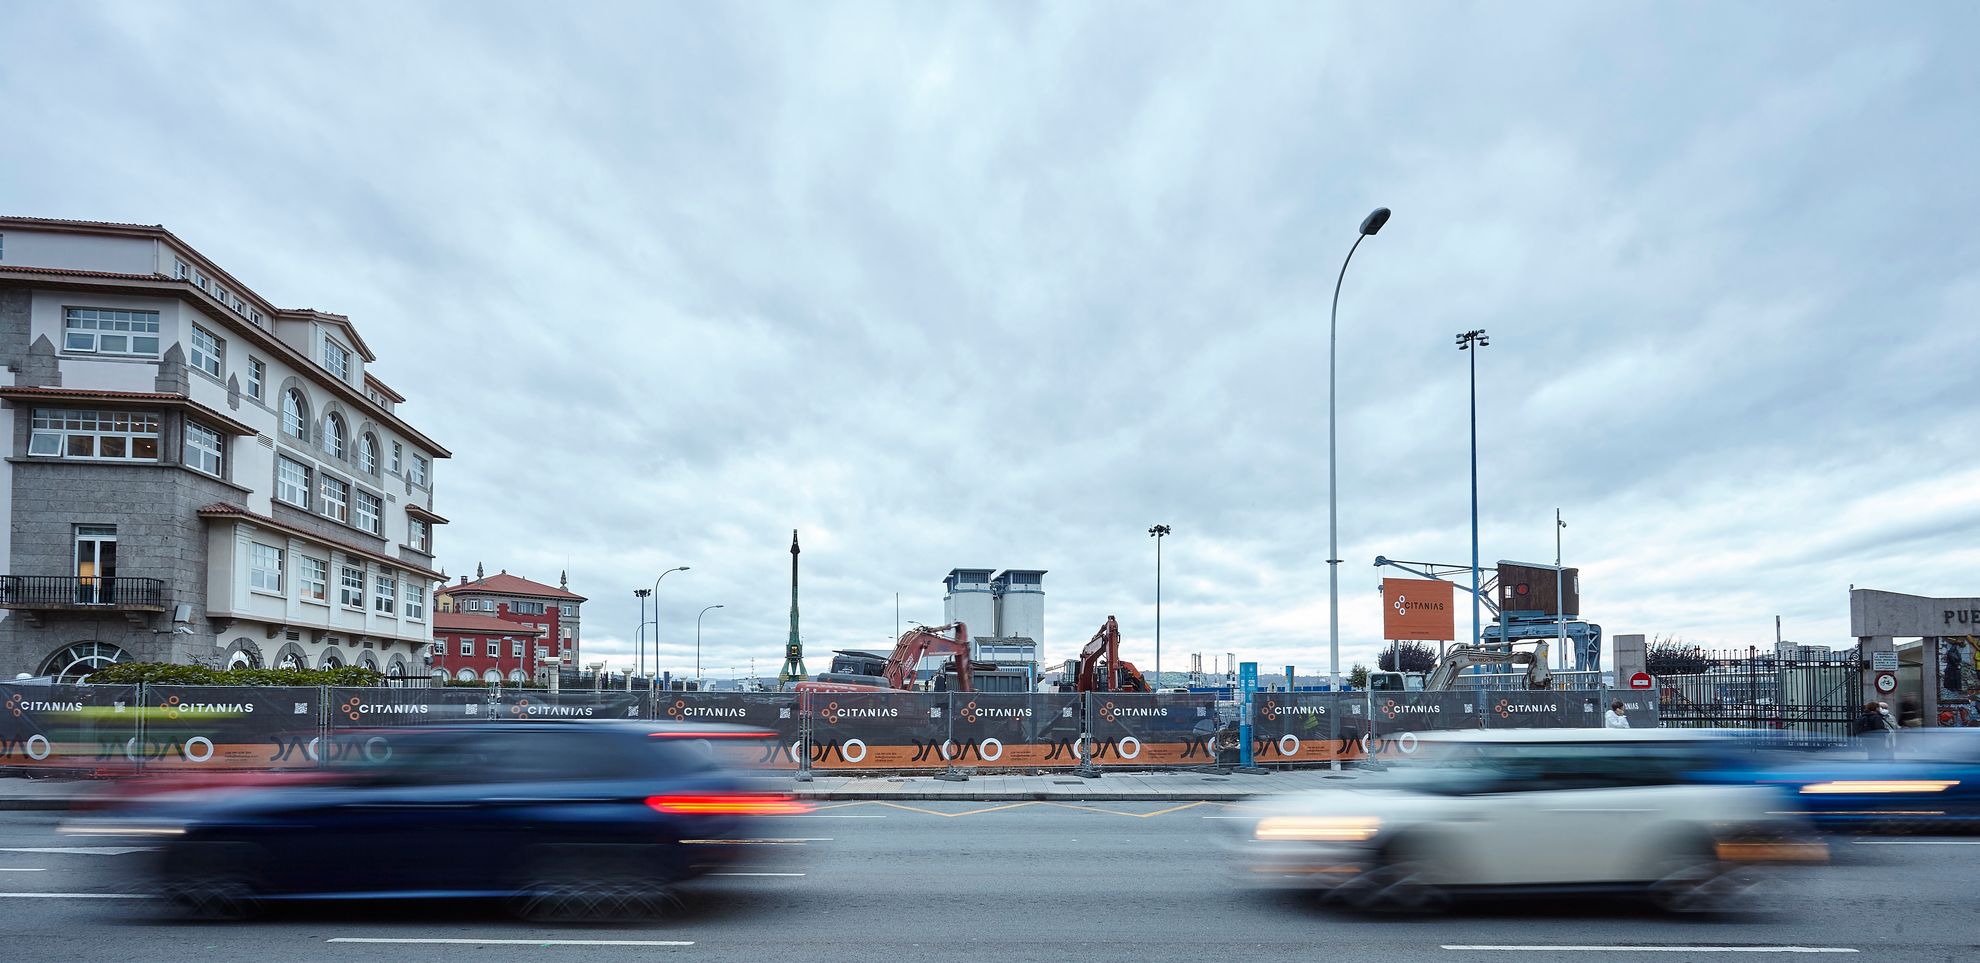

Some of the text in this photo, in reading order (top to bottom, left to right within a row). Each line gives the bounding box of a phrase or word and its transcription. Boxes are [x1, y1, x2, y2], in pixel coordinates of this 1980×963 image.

[1404, 602, 1444, 610] CITANIAS
[20, 701, 83, 712] CITANIAS
[178, 703, 254, 713] CITANIAS
[358, 704, 429, 714] CITANIAS
[528, 706, 593, 716] CITANIAS
[1274, 706, 1326, 715] CITANIAS
[1394, 705, 1440, 714] CITANIAS
[1508, 704, 1557, 712] CITANIAS
[684, 707, 746, 717] CITANIAS
[837, 708, 898, 718] CITANIAS
[975, 708, 1033, 717] CITANIAS
[1114, 708, 1168, 717] CITANIAS
